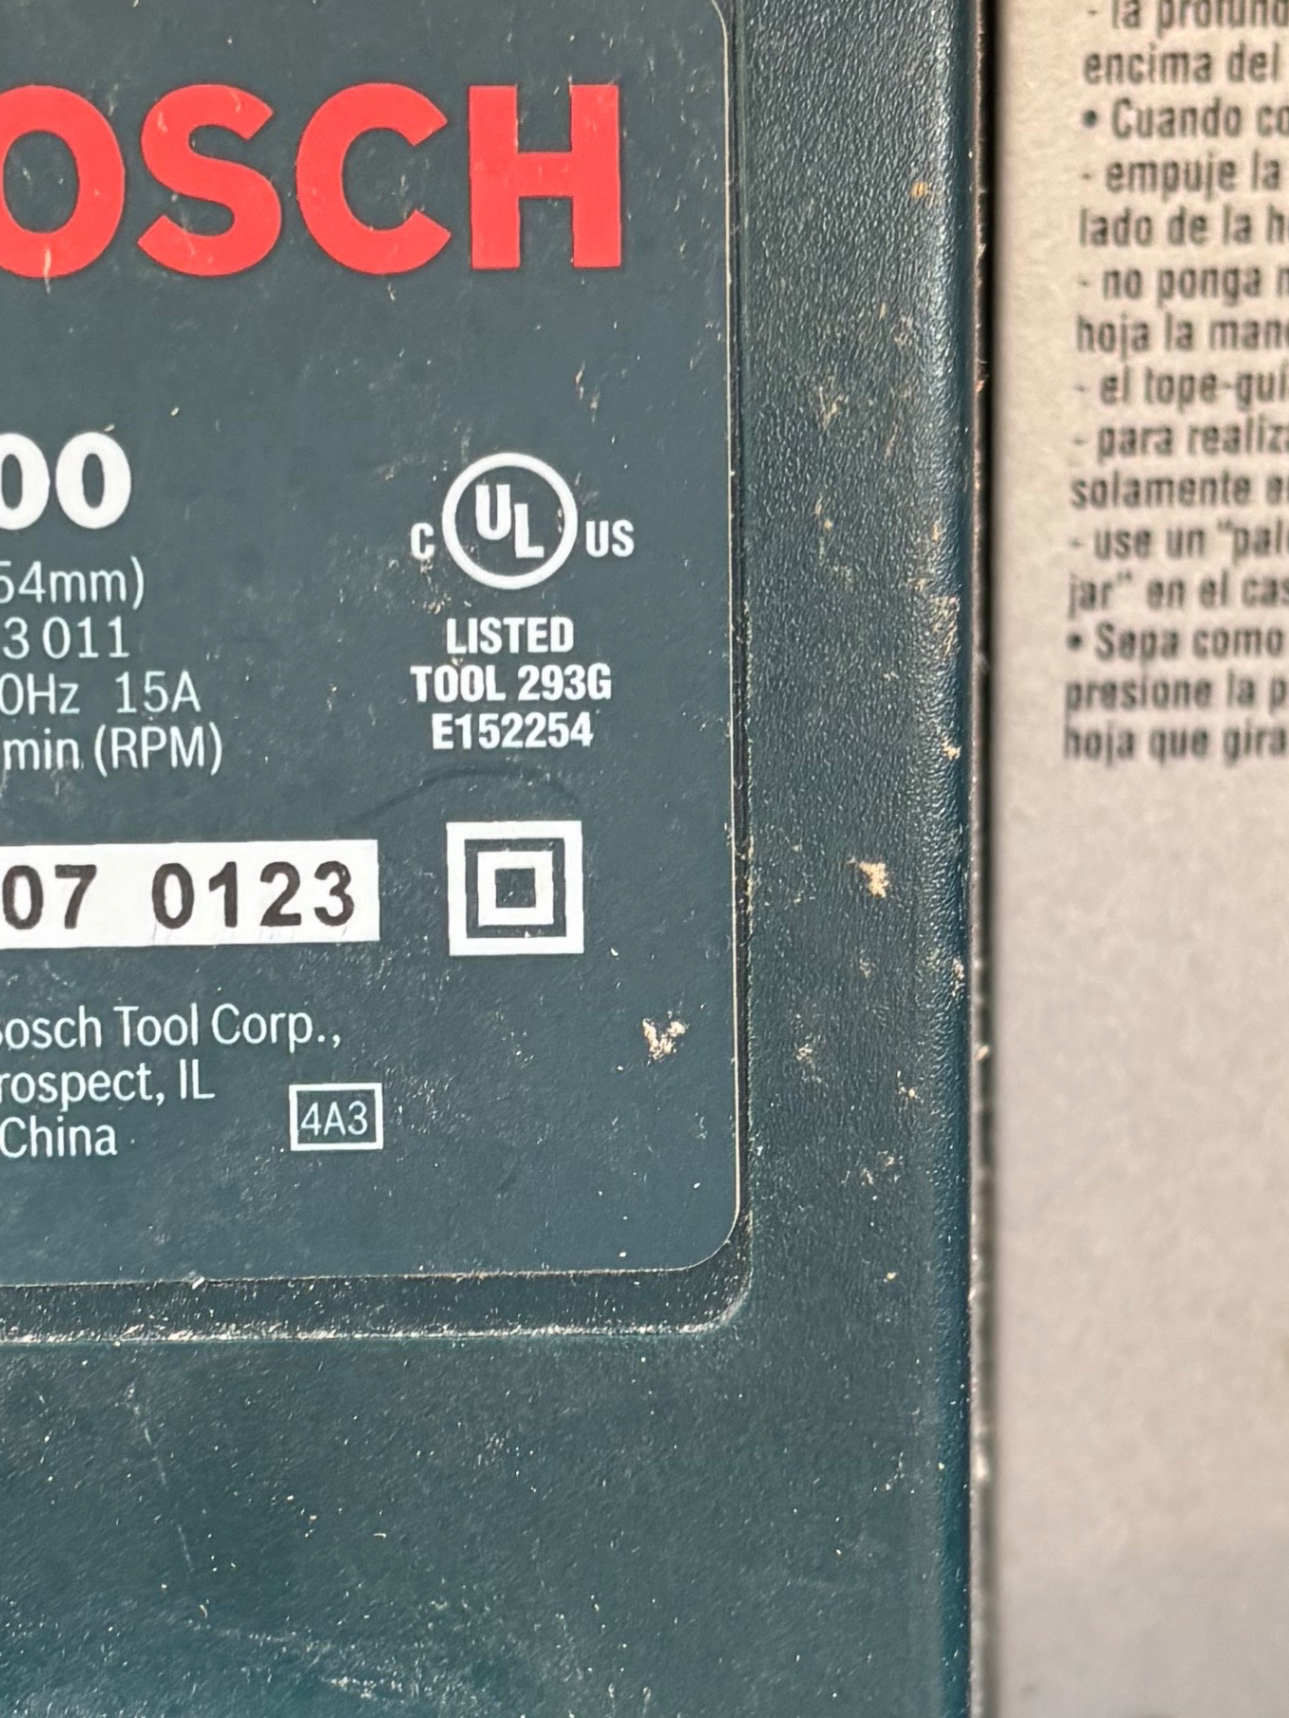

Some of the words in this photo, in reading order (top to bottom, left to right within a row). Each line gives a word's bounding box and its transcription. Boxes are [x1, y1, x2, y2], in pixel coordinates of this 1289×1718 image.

[1111, 96, 1244, 140] Cuando
[476, 484, 544, 558] UL
[586, 520, 634, 557] US
[447, 616, 573, 654] LISTED
[116, 671, 200, 712] 15A
[410, 665, 506, 702] TOOL
[518, 663, 611, 700] 293G
[95, 727, 222, 776] (RPM)
[432, 712, 593, 749] E152254
[1064, 722, 1137, 767] hoja
[1149, 728, 1210, 765] que
[152, 861, 354, 929] 0123
[114, 1003, 198, 1046] Tool
[212, 1003, 340, 1053] Corp.,
[180, 1059, 215, 1099] IL
[301, 1101, 367, 1135] 4A3
